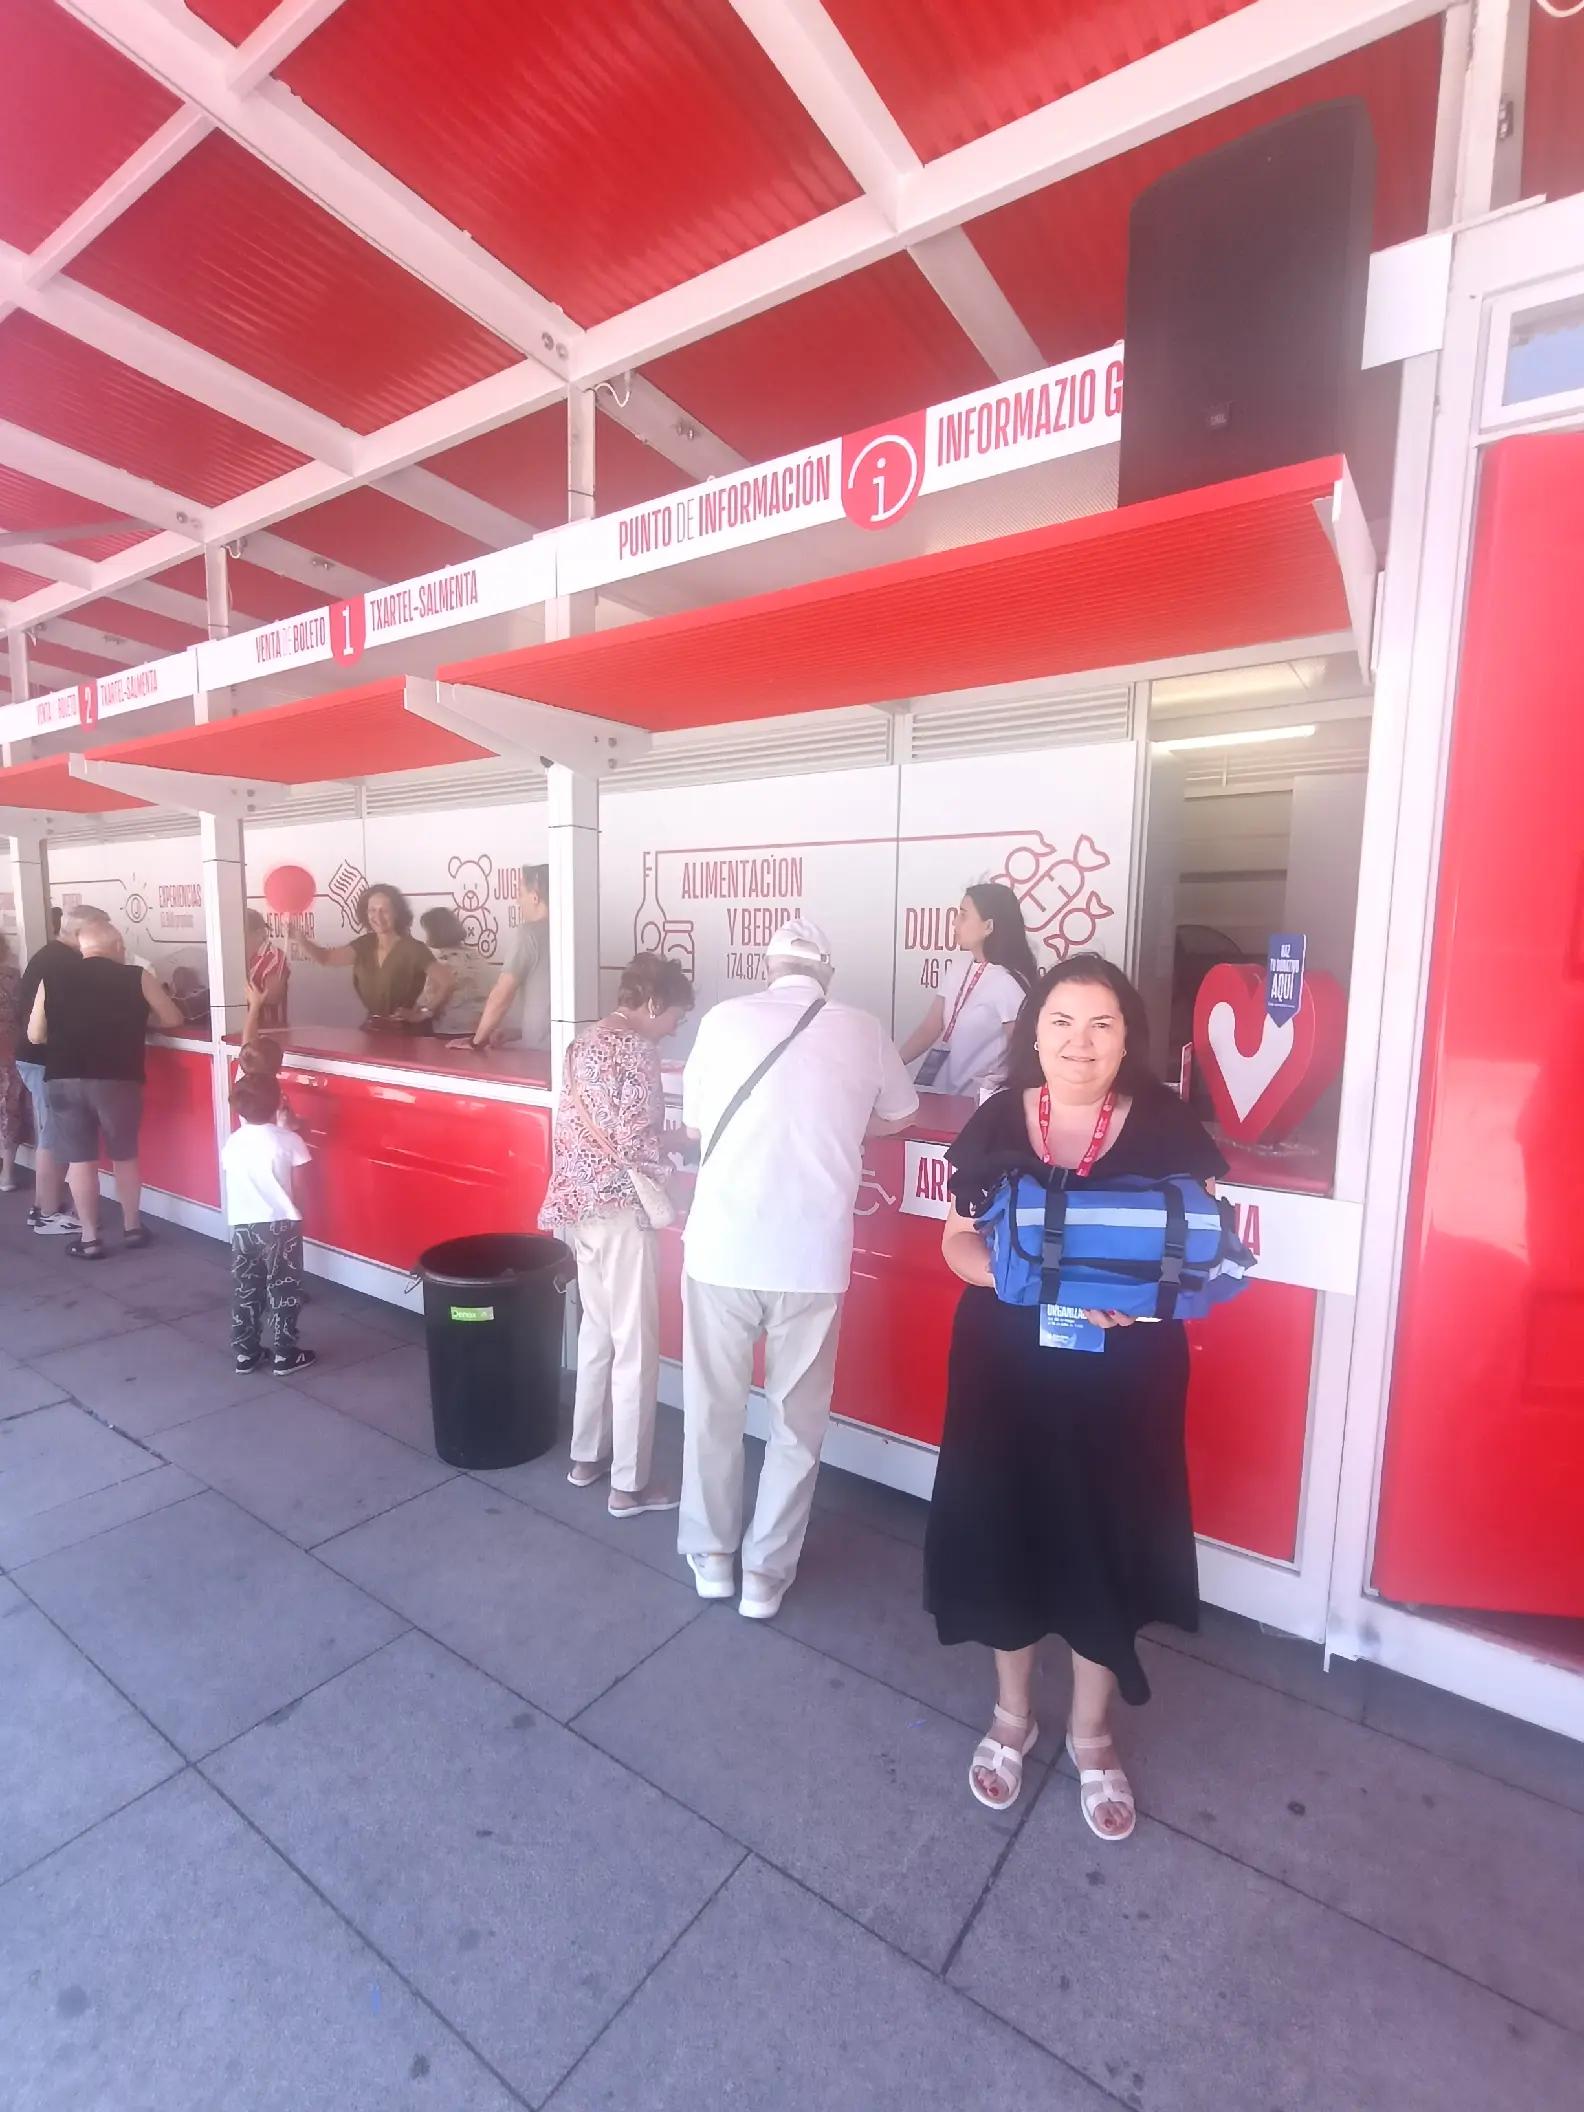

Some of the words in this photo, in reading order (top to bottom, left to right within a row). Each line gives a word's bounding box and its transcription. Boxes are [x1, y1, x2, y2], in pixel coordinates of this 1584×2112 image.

[937, 369, 1096, 466] INFORMAZIO
[619, 506, 672, 560] PUNTO
[677, 498, 694, 543] DE
[699, 454, 830, 536] INFORMACIÓN
[370, 570, 478, 631] TXARTEL-SALMENTA
[256, 632, 281, 663] VENTA
[293, 617, 326, 653] BOLETO
[342, 605, 354, 656] 1
[85, 687, 93, 723] 2
[727, 908, 737, 946] Y
